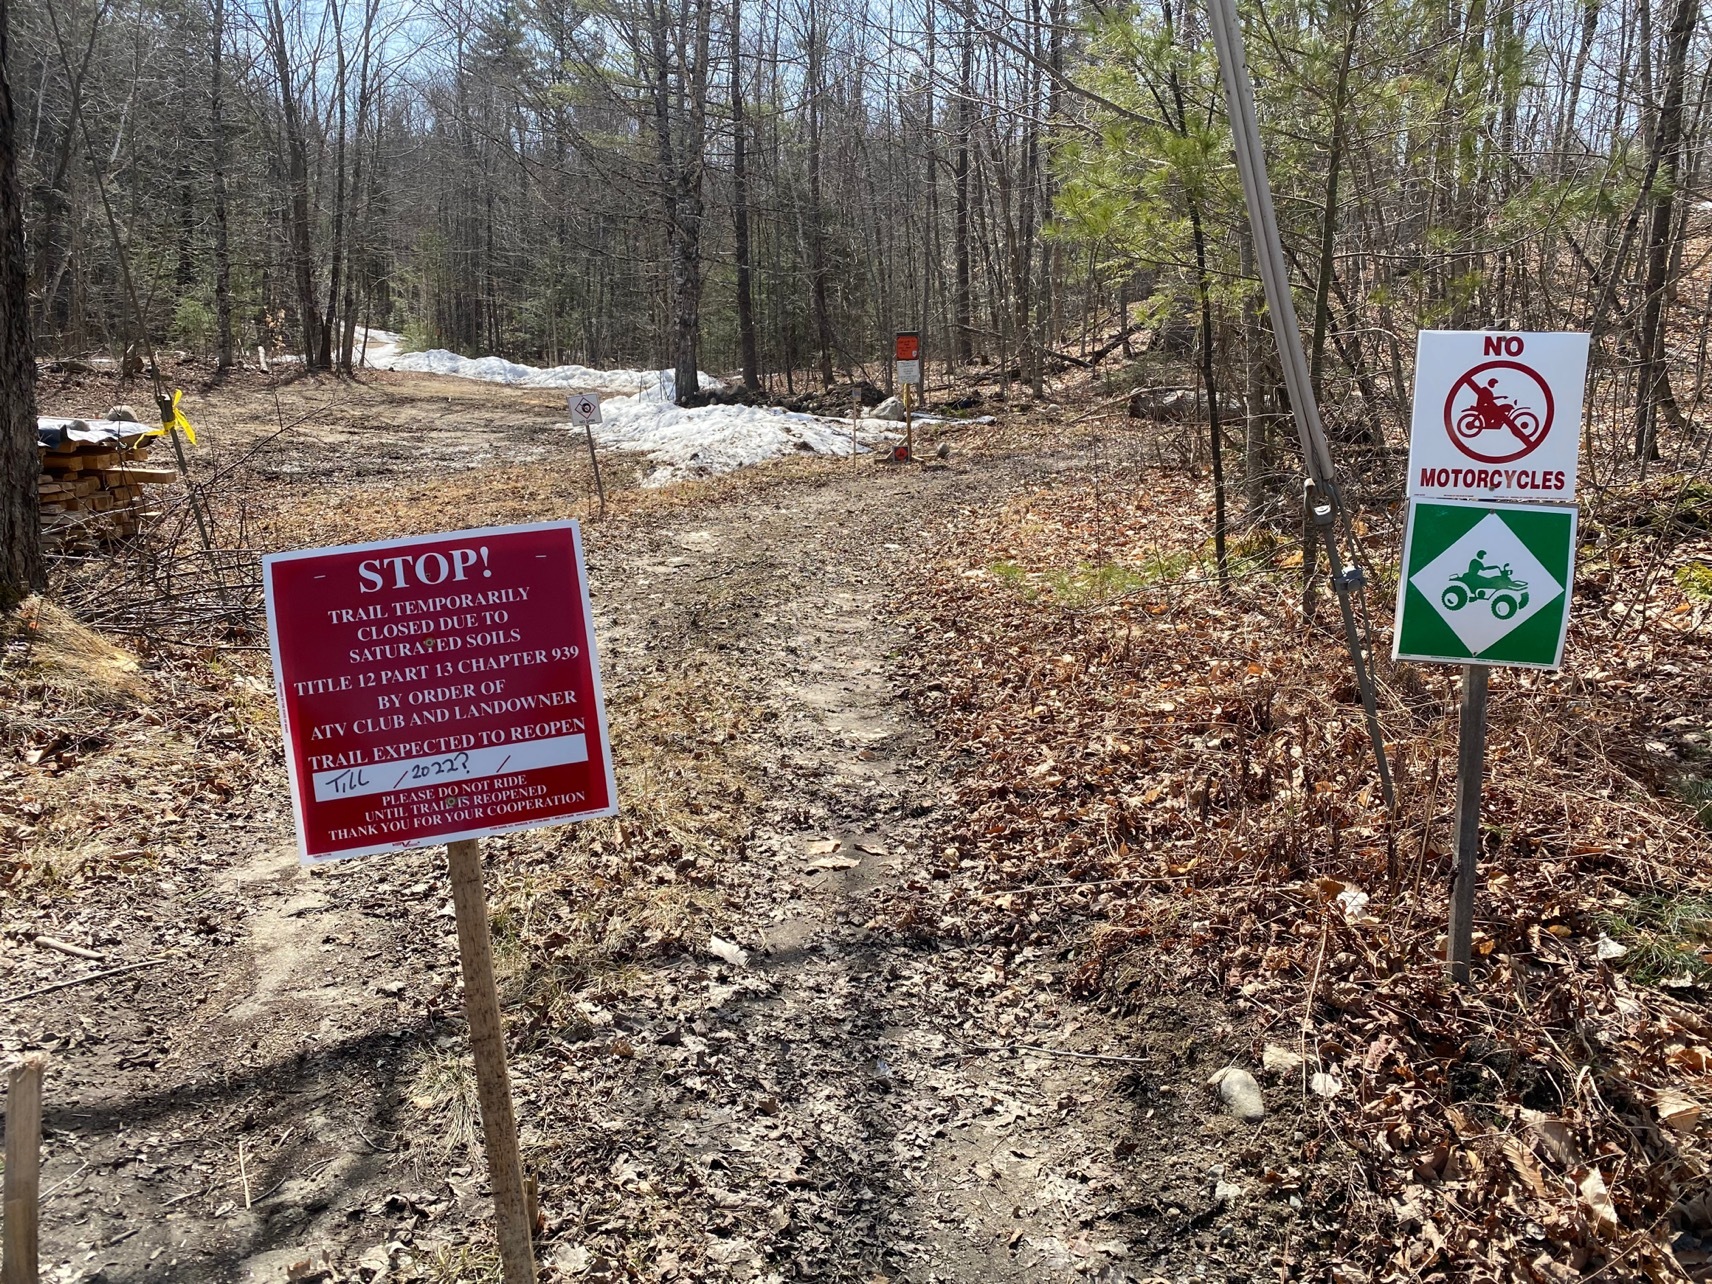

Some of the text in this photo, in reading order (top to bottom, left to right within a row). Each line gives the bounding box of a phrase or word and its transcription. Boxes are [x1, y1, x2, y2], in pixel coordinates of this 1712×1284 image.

[1483, 336, 1524, 357] NO
[1420, 468, 1565, 491] MOTORCYCLES
[358, 546, 492, 593] STOP!
[328, 586, 530, 624] TRAIL TEMPORARILY
[357, 609, 509, 641] CLOSED DUE TO
[466, 628, 521, 648] SOILS
[294, 645, 579, 696] TITLE 12 PART 13 CHAPTER 939
[378, 679, 506, 710] BY ORDER OF
[311, 690, 577, 741] ATV CLUB AND LANDOWNER
[308, 717, 586, 770] TRAIL EXPECTED TO REOPEN
[365, 807, 408, 823] UNTIL
[457, 795, 470, 808] IS
[473, 784, 547, 806] REOPENED
[382, 774, 527, 807] PLEASE DO NOT RIDE
[327, 824, 378, 841] THANK
[380, 817, 411, 834] YOU
[413, 813, 443, 829] FOR
[445, 806, 485, 824] YOUR
[486, 790, 586, 816] COOPERATION
